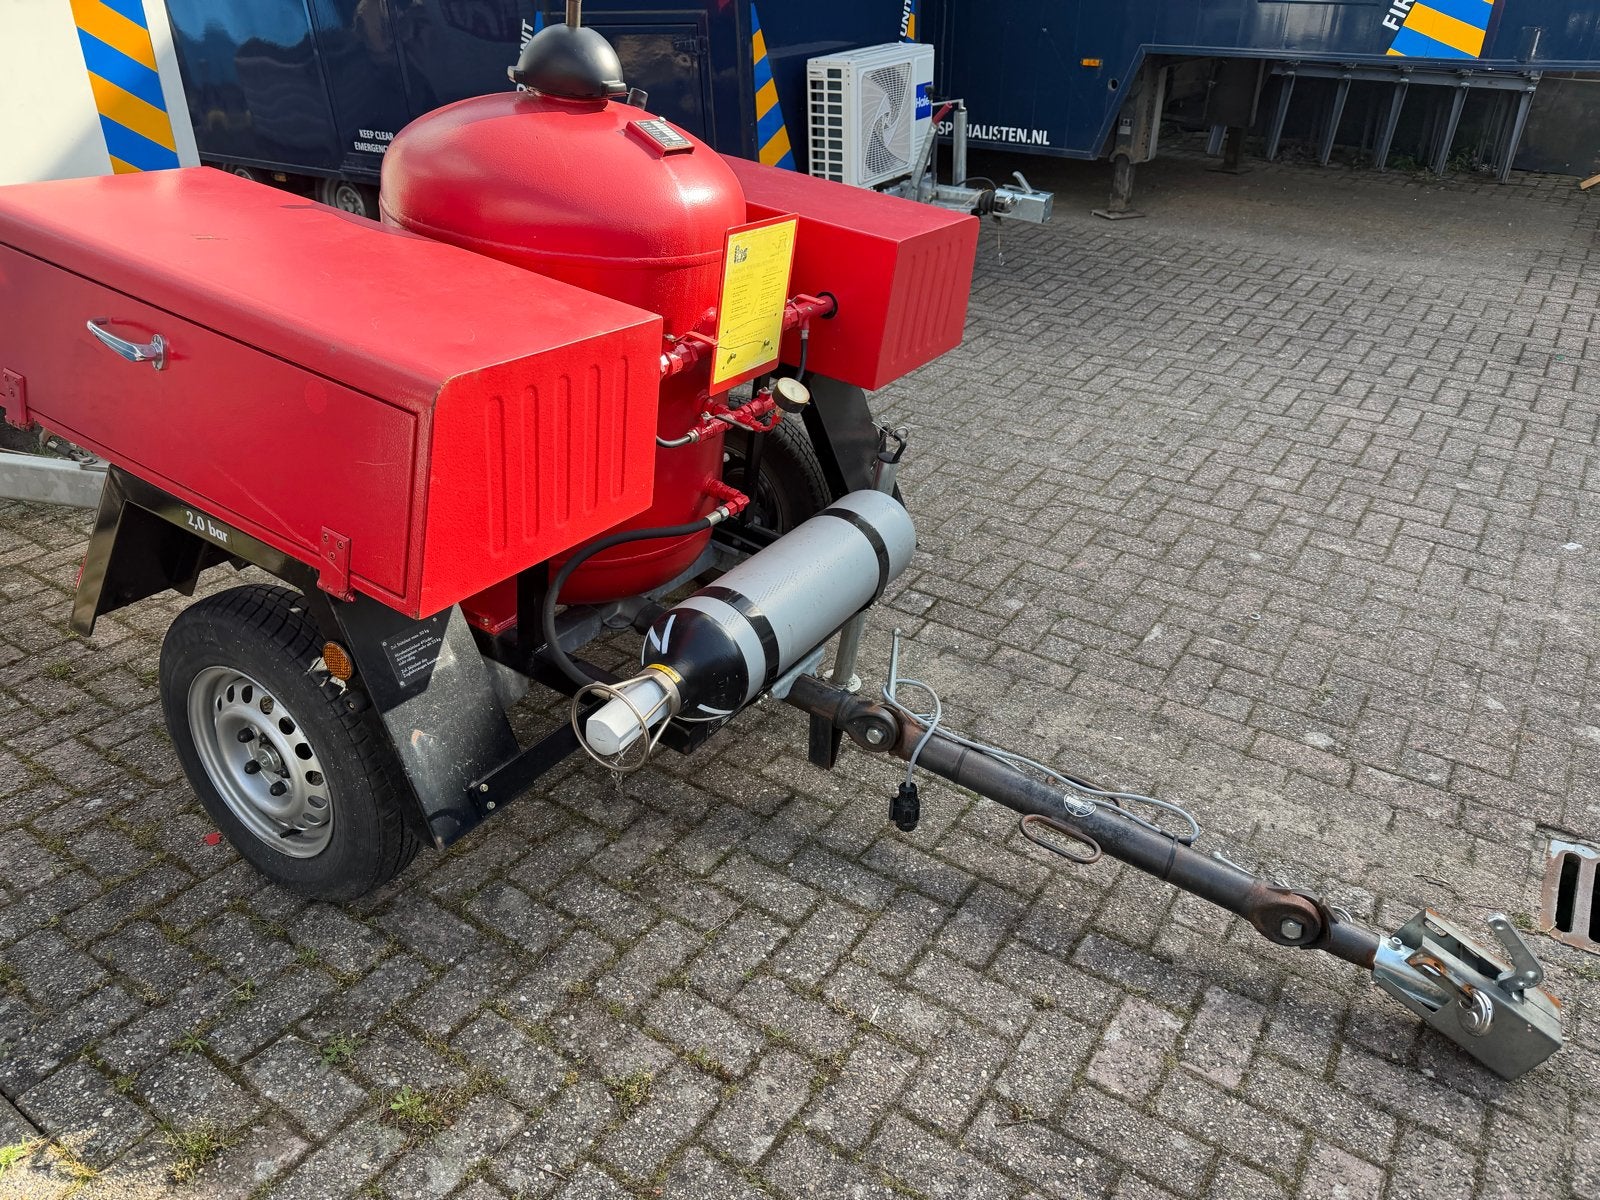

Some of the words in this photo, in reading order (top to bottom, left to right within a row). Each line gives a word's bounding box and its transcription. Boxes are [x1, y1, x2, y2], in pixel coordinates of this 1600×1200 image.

[915, 95, 930, 108] Haie
[359, 129, 374, 139] KEEP
[375, 131, 394, 140] CLEAR
[937, 121, 1050, 146] SPIALISTEN.NL
[186, 510, 205, 531] 2,0
[208, 519, 228, 542] bar
